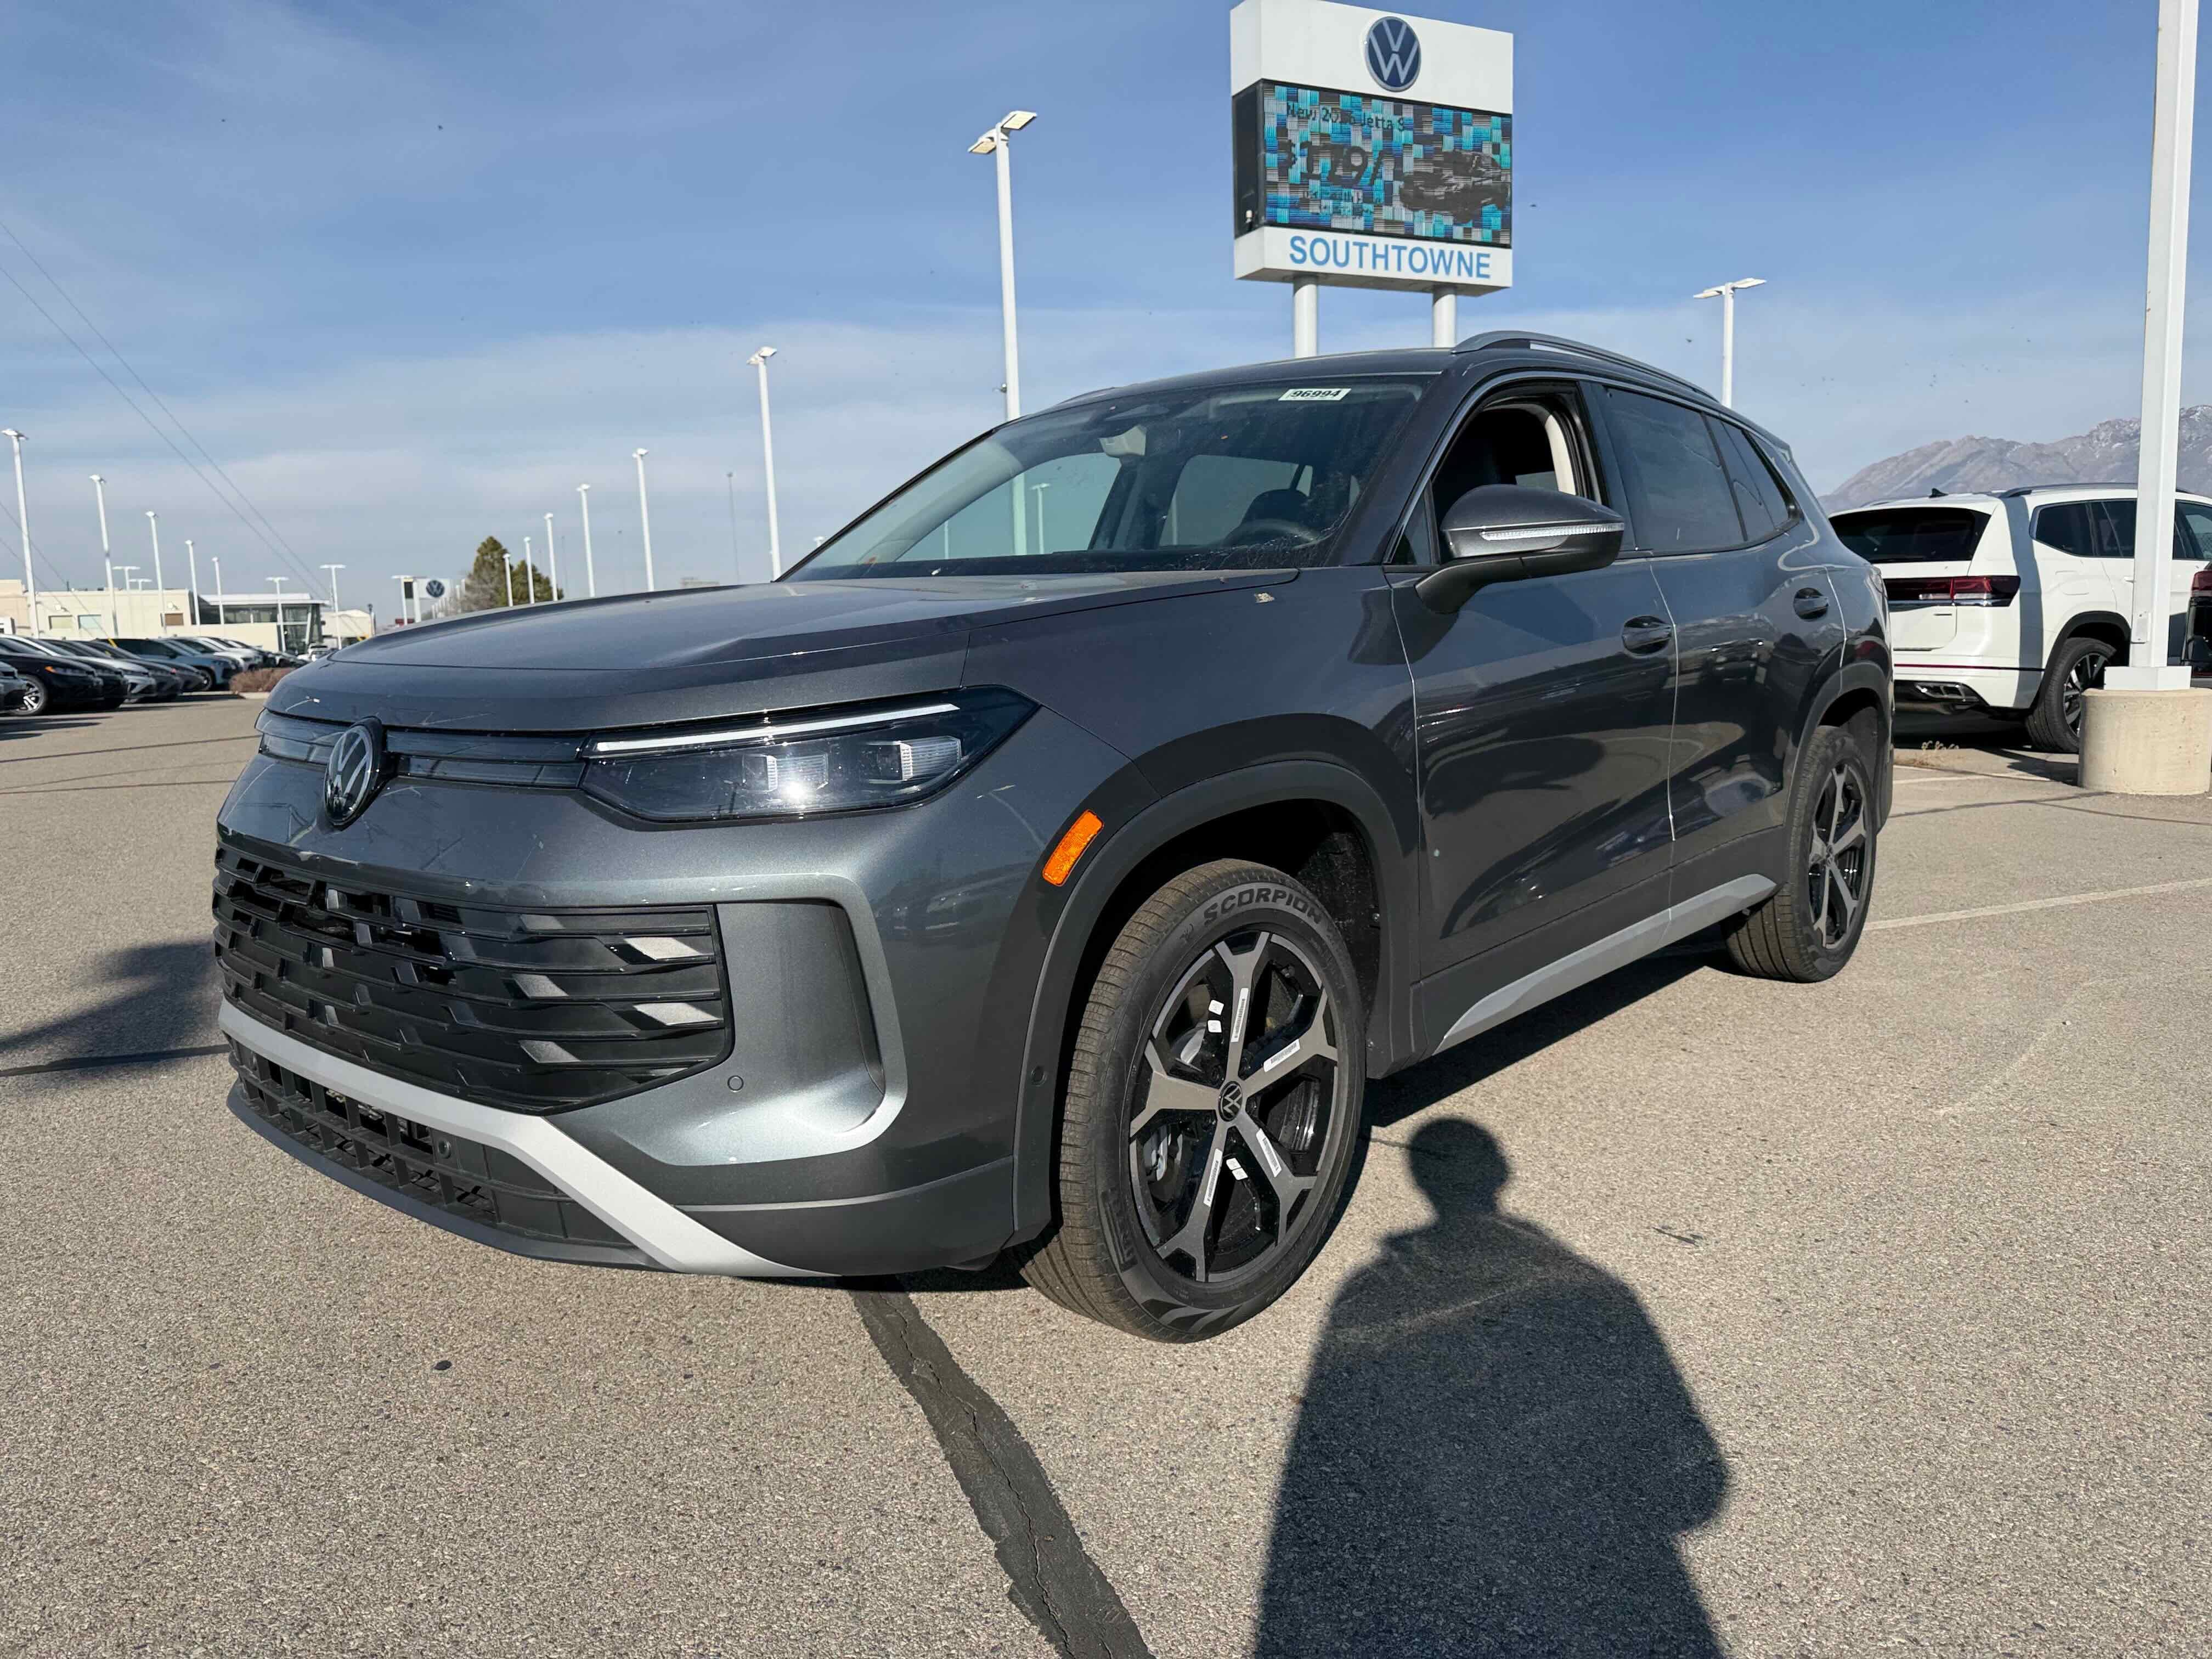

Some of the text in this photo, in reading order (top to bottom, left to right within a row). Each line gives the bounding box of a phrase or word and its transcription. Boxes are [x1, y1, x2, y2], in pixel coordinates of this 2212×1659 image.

[1360, 112, 1394, 130] Jetta
[1289, 235, 1491, 279] SOUTHTOWNE
[1203, 888, 1322, 926] SCORPION
